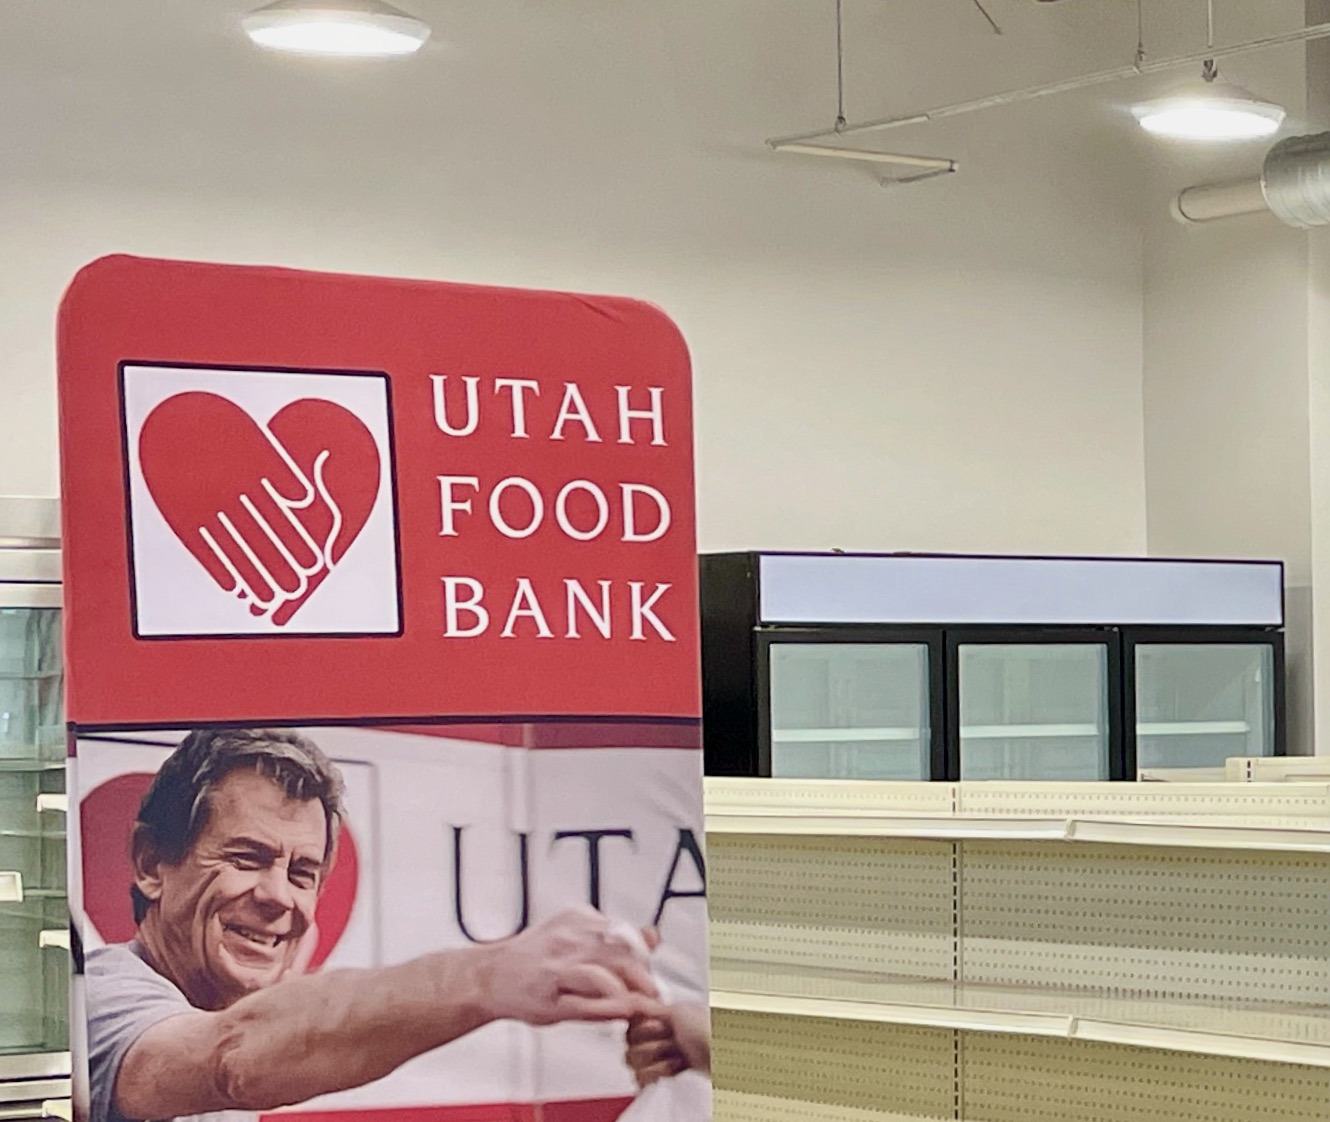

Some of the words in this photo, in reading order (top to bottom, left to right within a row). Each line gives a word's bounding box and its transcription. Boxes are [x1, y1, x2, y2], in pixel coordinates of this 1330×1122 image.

[428, 373, 668, 446] UTAH
[435, 474, 672, 543] FOOD
[440, 576, 677, 642] BANK
